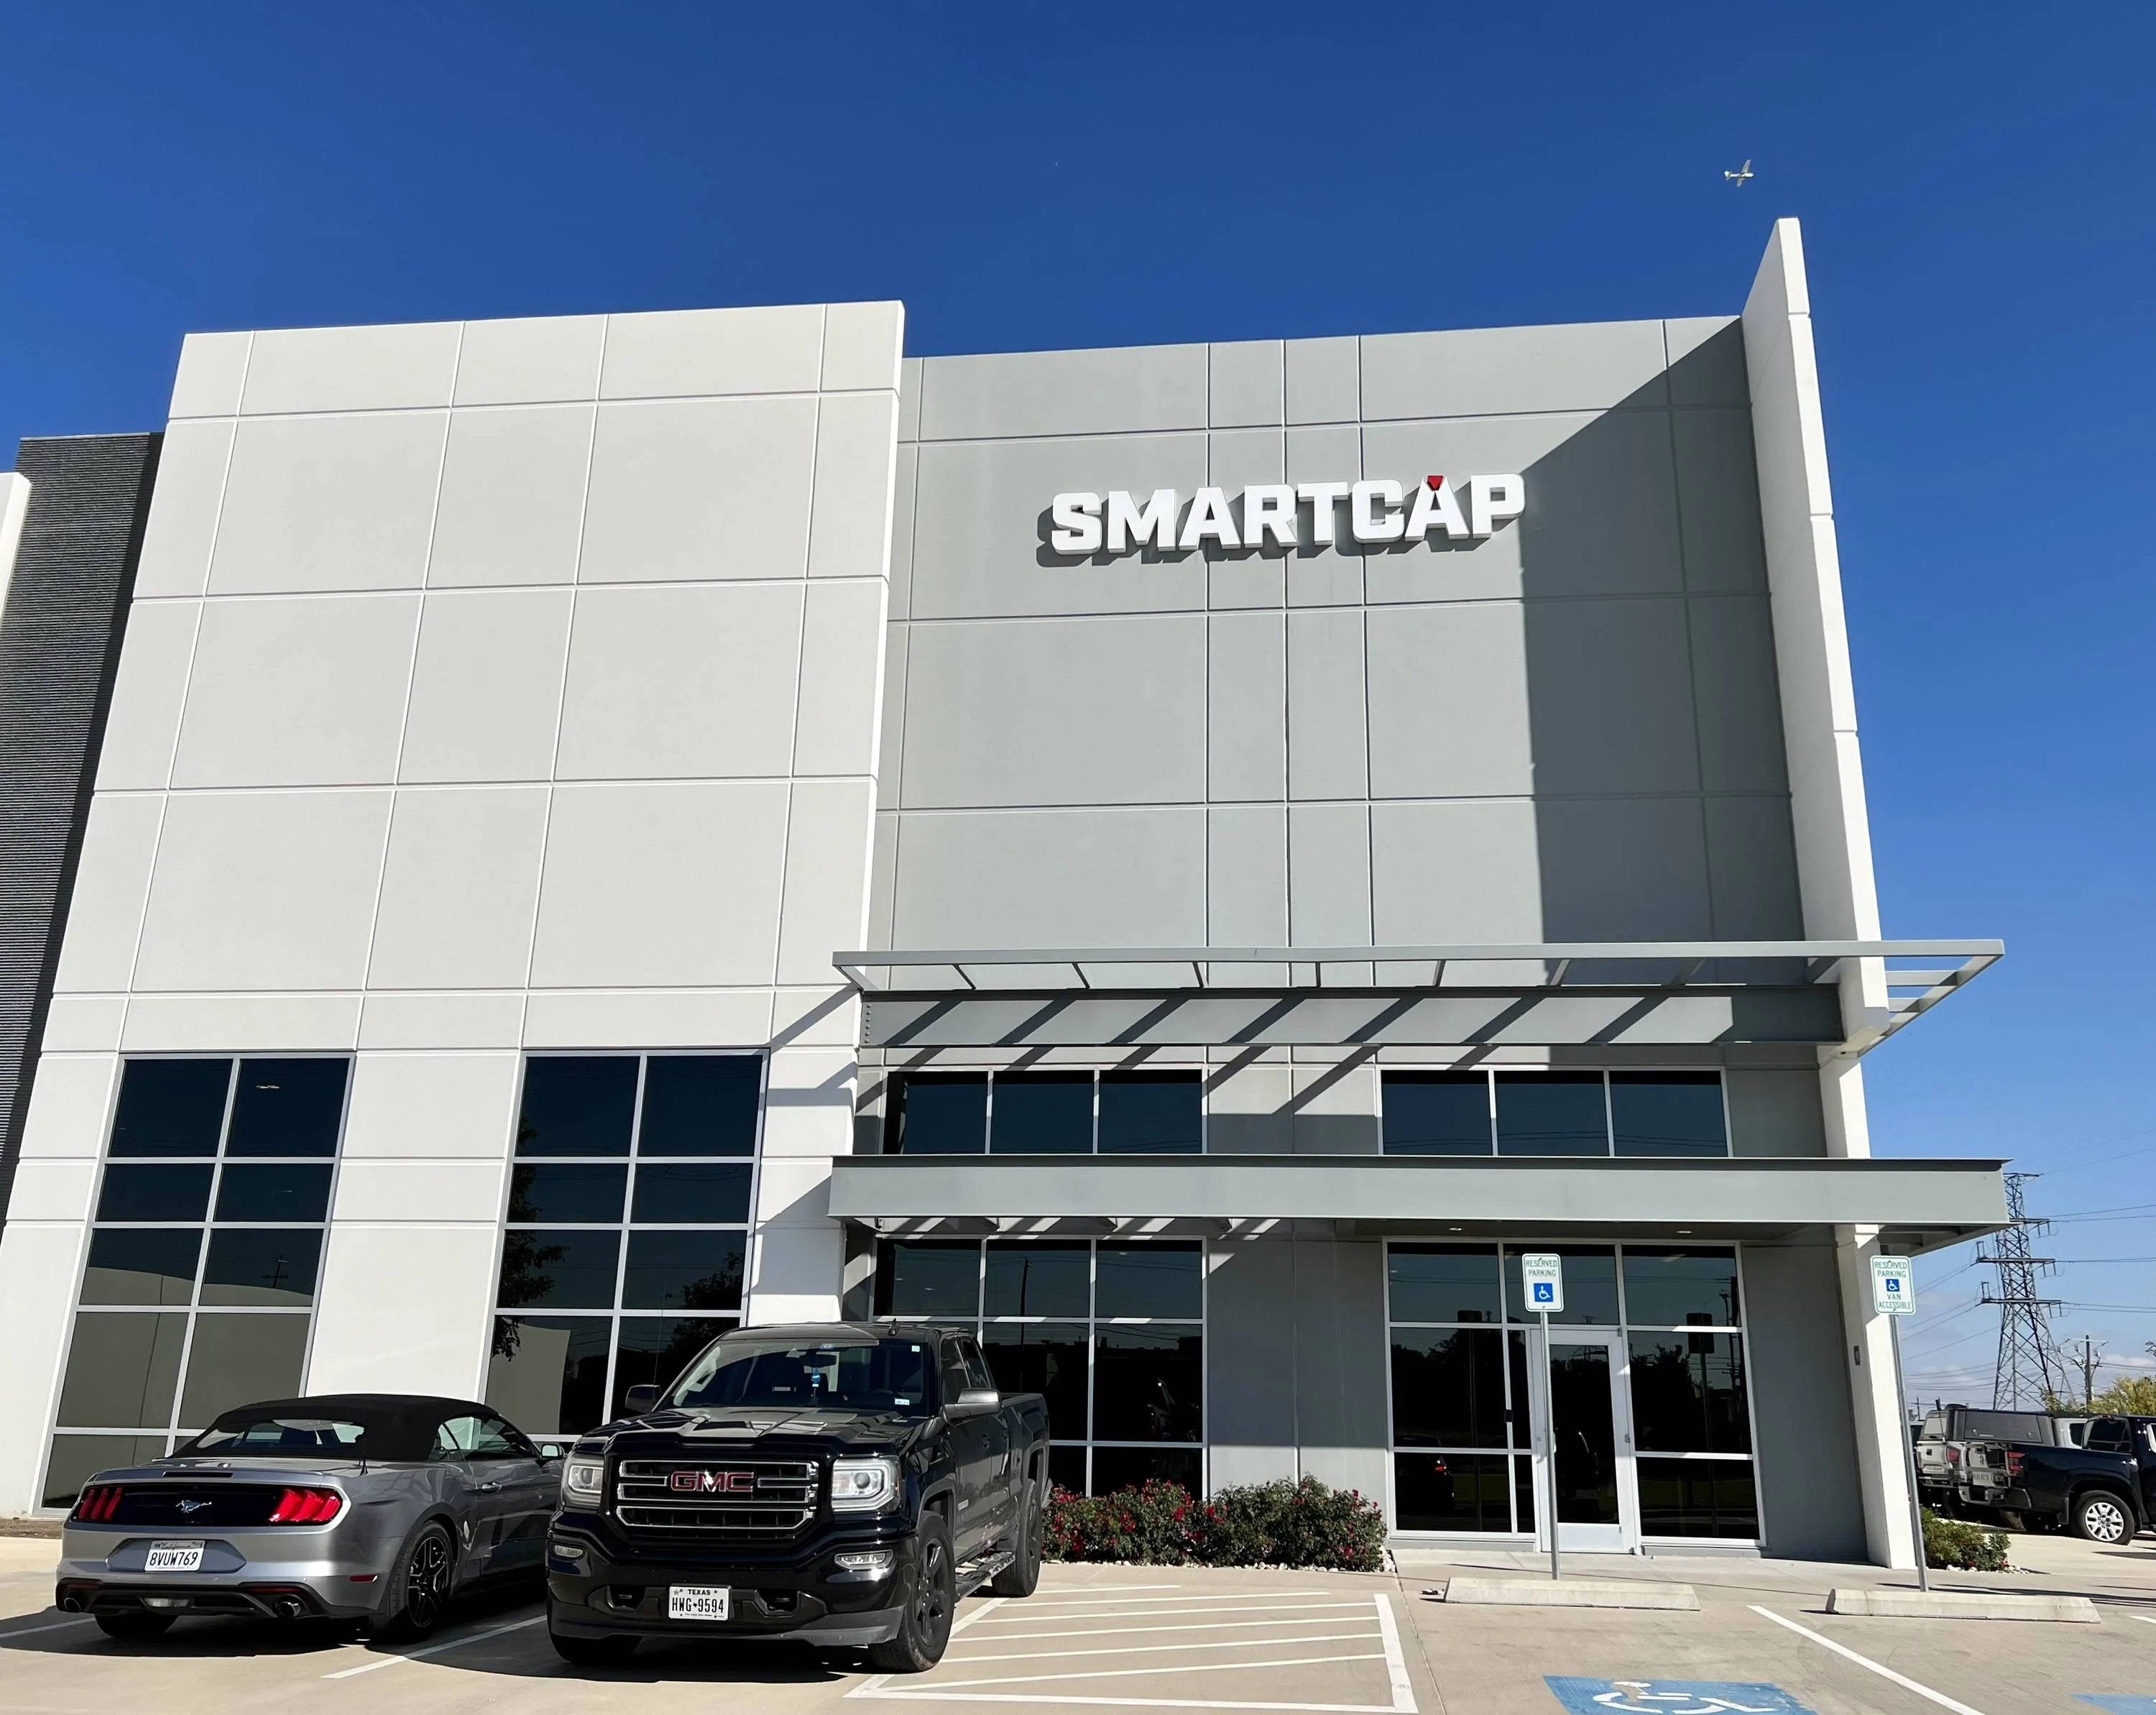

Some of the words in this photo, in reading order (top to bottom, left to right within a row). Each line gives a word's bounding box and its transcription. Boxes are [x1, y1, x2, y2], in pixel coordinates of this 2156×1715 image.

[1051, 474, 1526, 555] SMARTCAP
[1874, 1261, 1907, 1269] RESERVED
[1879, 1301, 1912, 1310] ACCESSIBLE
[671, 1471, 754, 1492] GMC
[149, 1552, 198, 1566] 8VUW769
